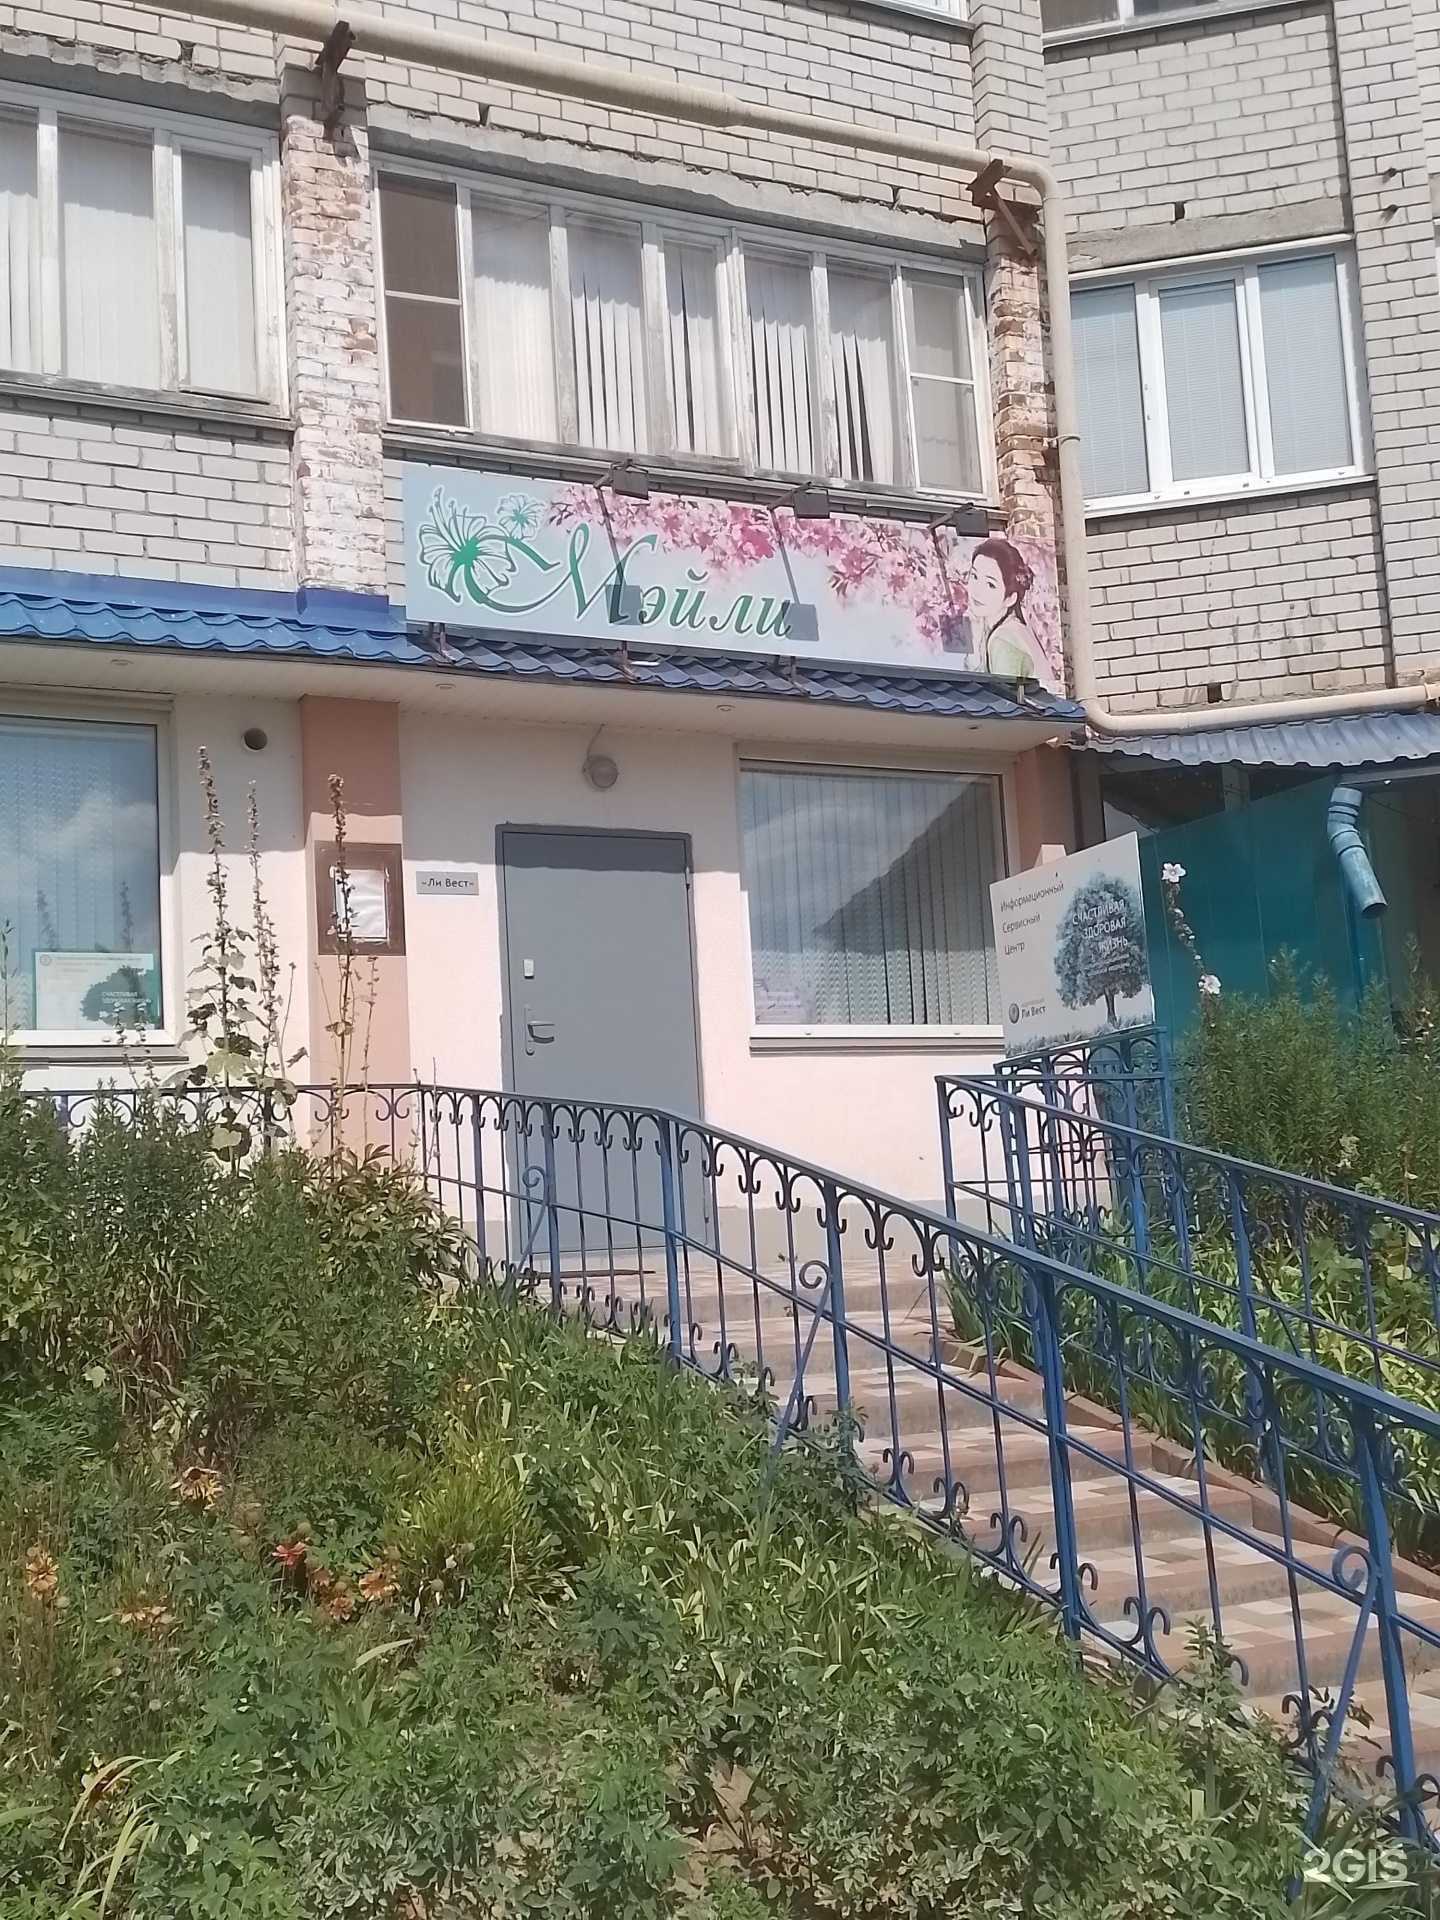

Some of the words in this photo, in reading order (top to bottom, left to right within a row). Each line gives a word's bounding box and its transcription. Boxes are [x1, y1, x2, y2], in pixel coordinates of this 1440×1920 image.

[551, 522, 794, 638] Мэйли
[1000, 881, 1064, 912] Информационный
[1072, 898, 1126, 925] СЧАСТЛИВАЯ
[1002, 912, 1041, 934] Сервисный
[1082, 916, 1127, 939] ЗДОРОВАЯ
[1004, 941, 1025, 956] Центр
[1098, 936, 1129, 953] ЖИЗНЬ
[1031, 1005, 1046, 1016] Вест
